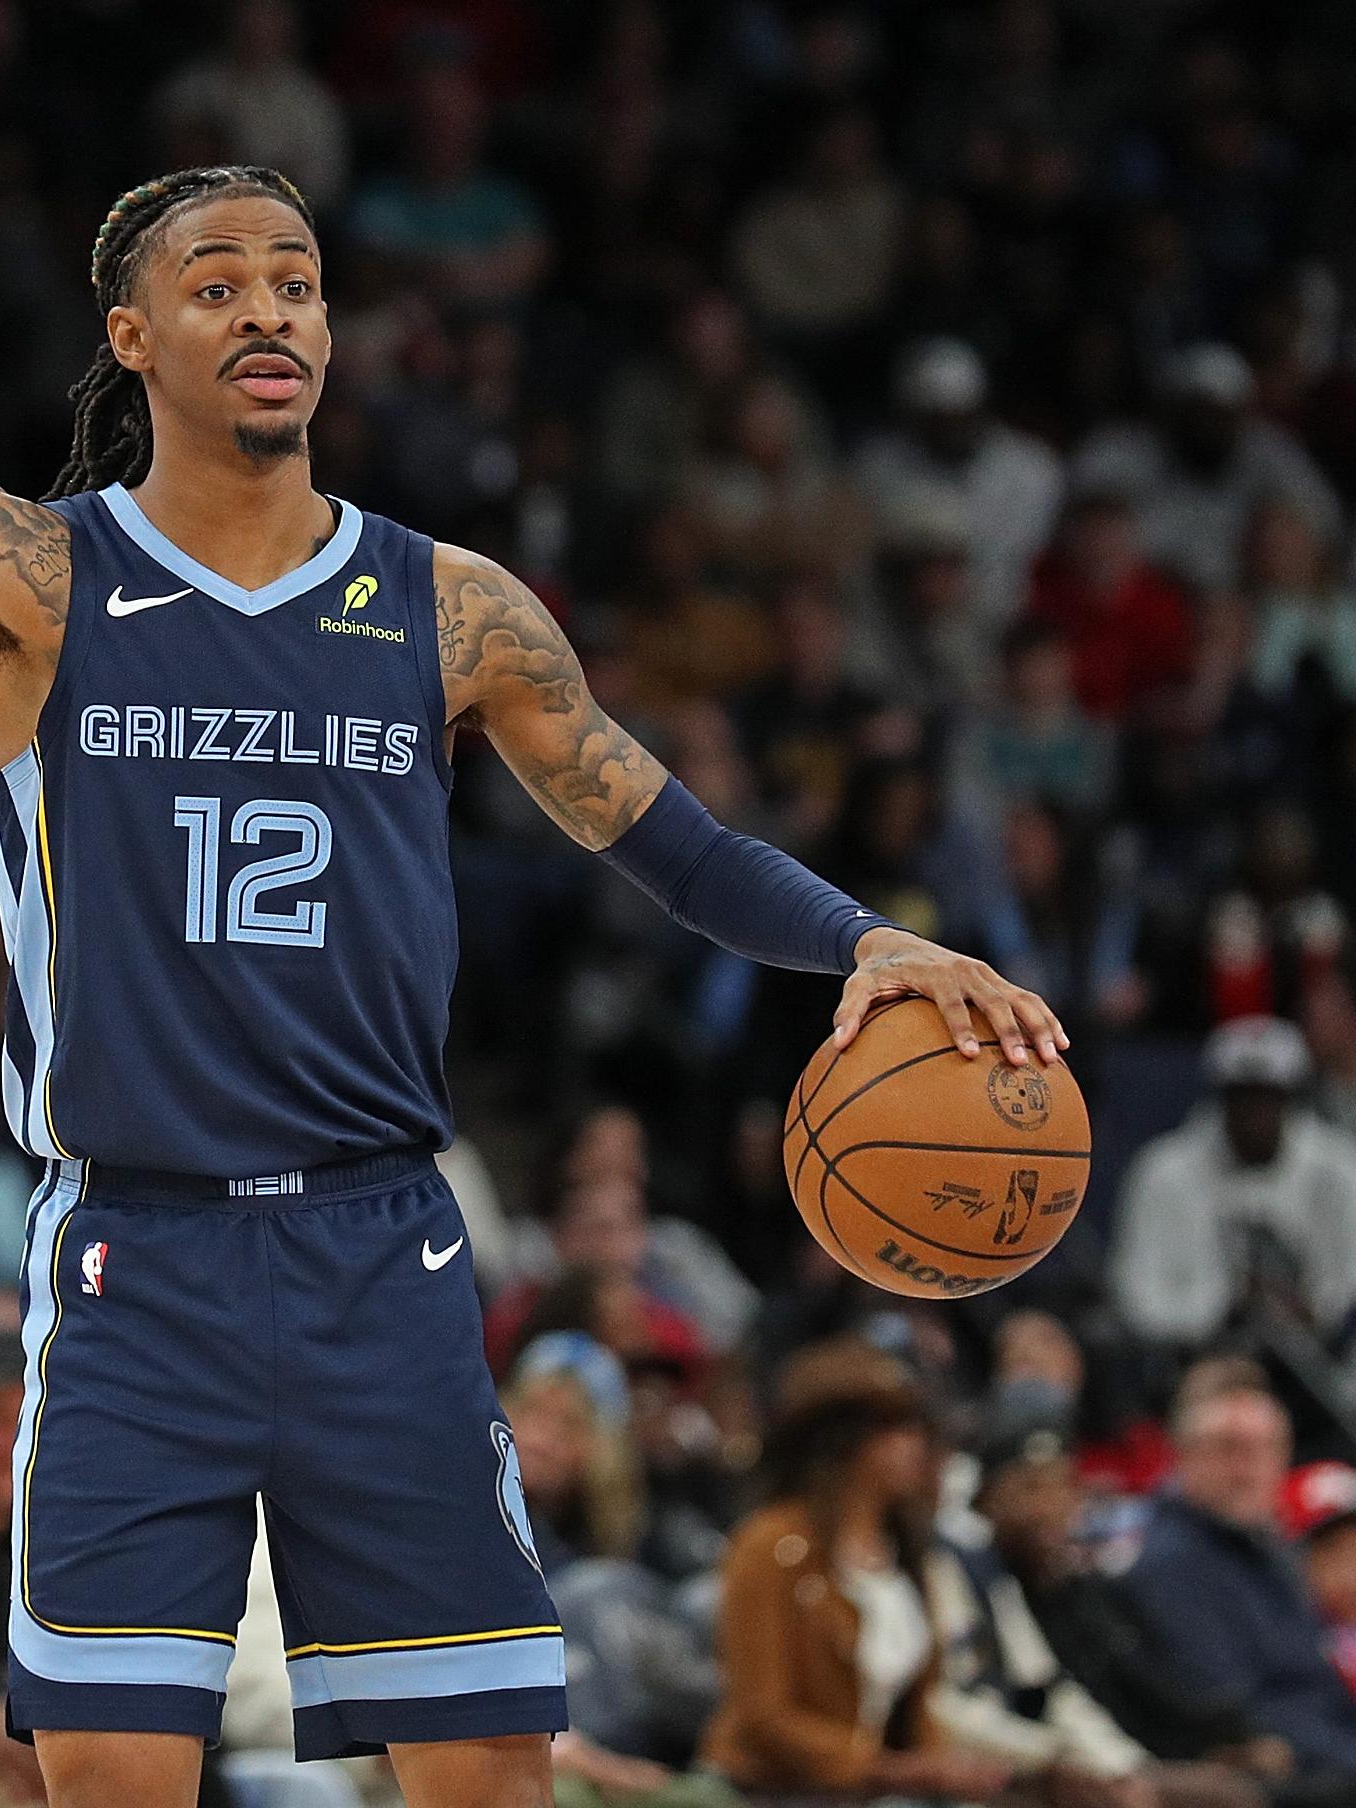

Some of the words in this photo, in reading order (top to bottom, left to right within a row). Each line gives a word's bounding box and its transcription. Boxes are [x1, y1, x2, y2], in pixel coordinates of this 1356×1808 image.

[319, 616, 405, 643] Robinhood
[79, 704, 419, 776] GRIZZLIES
[173, 795, 333, 949] 12
